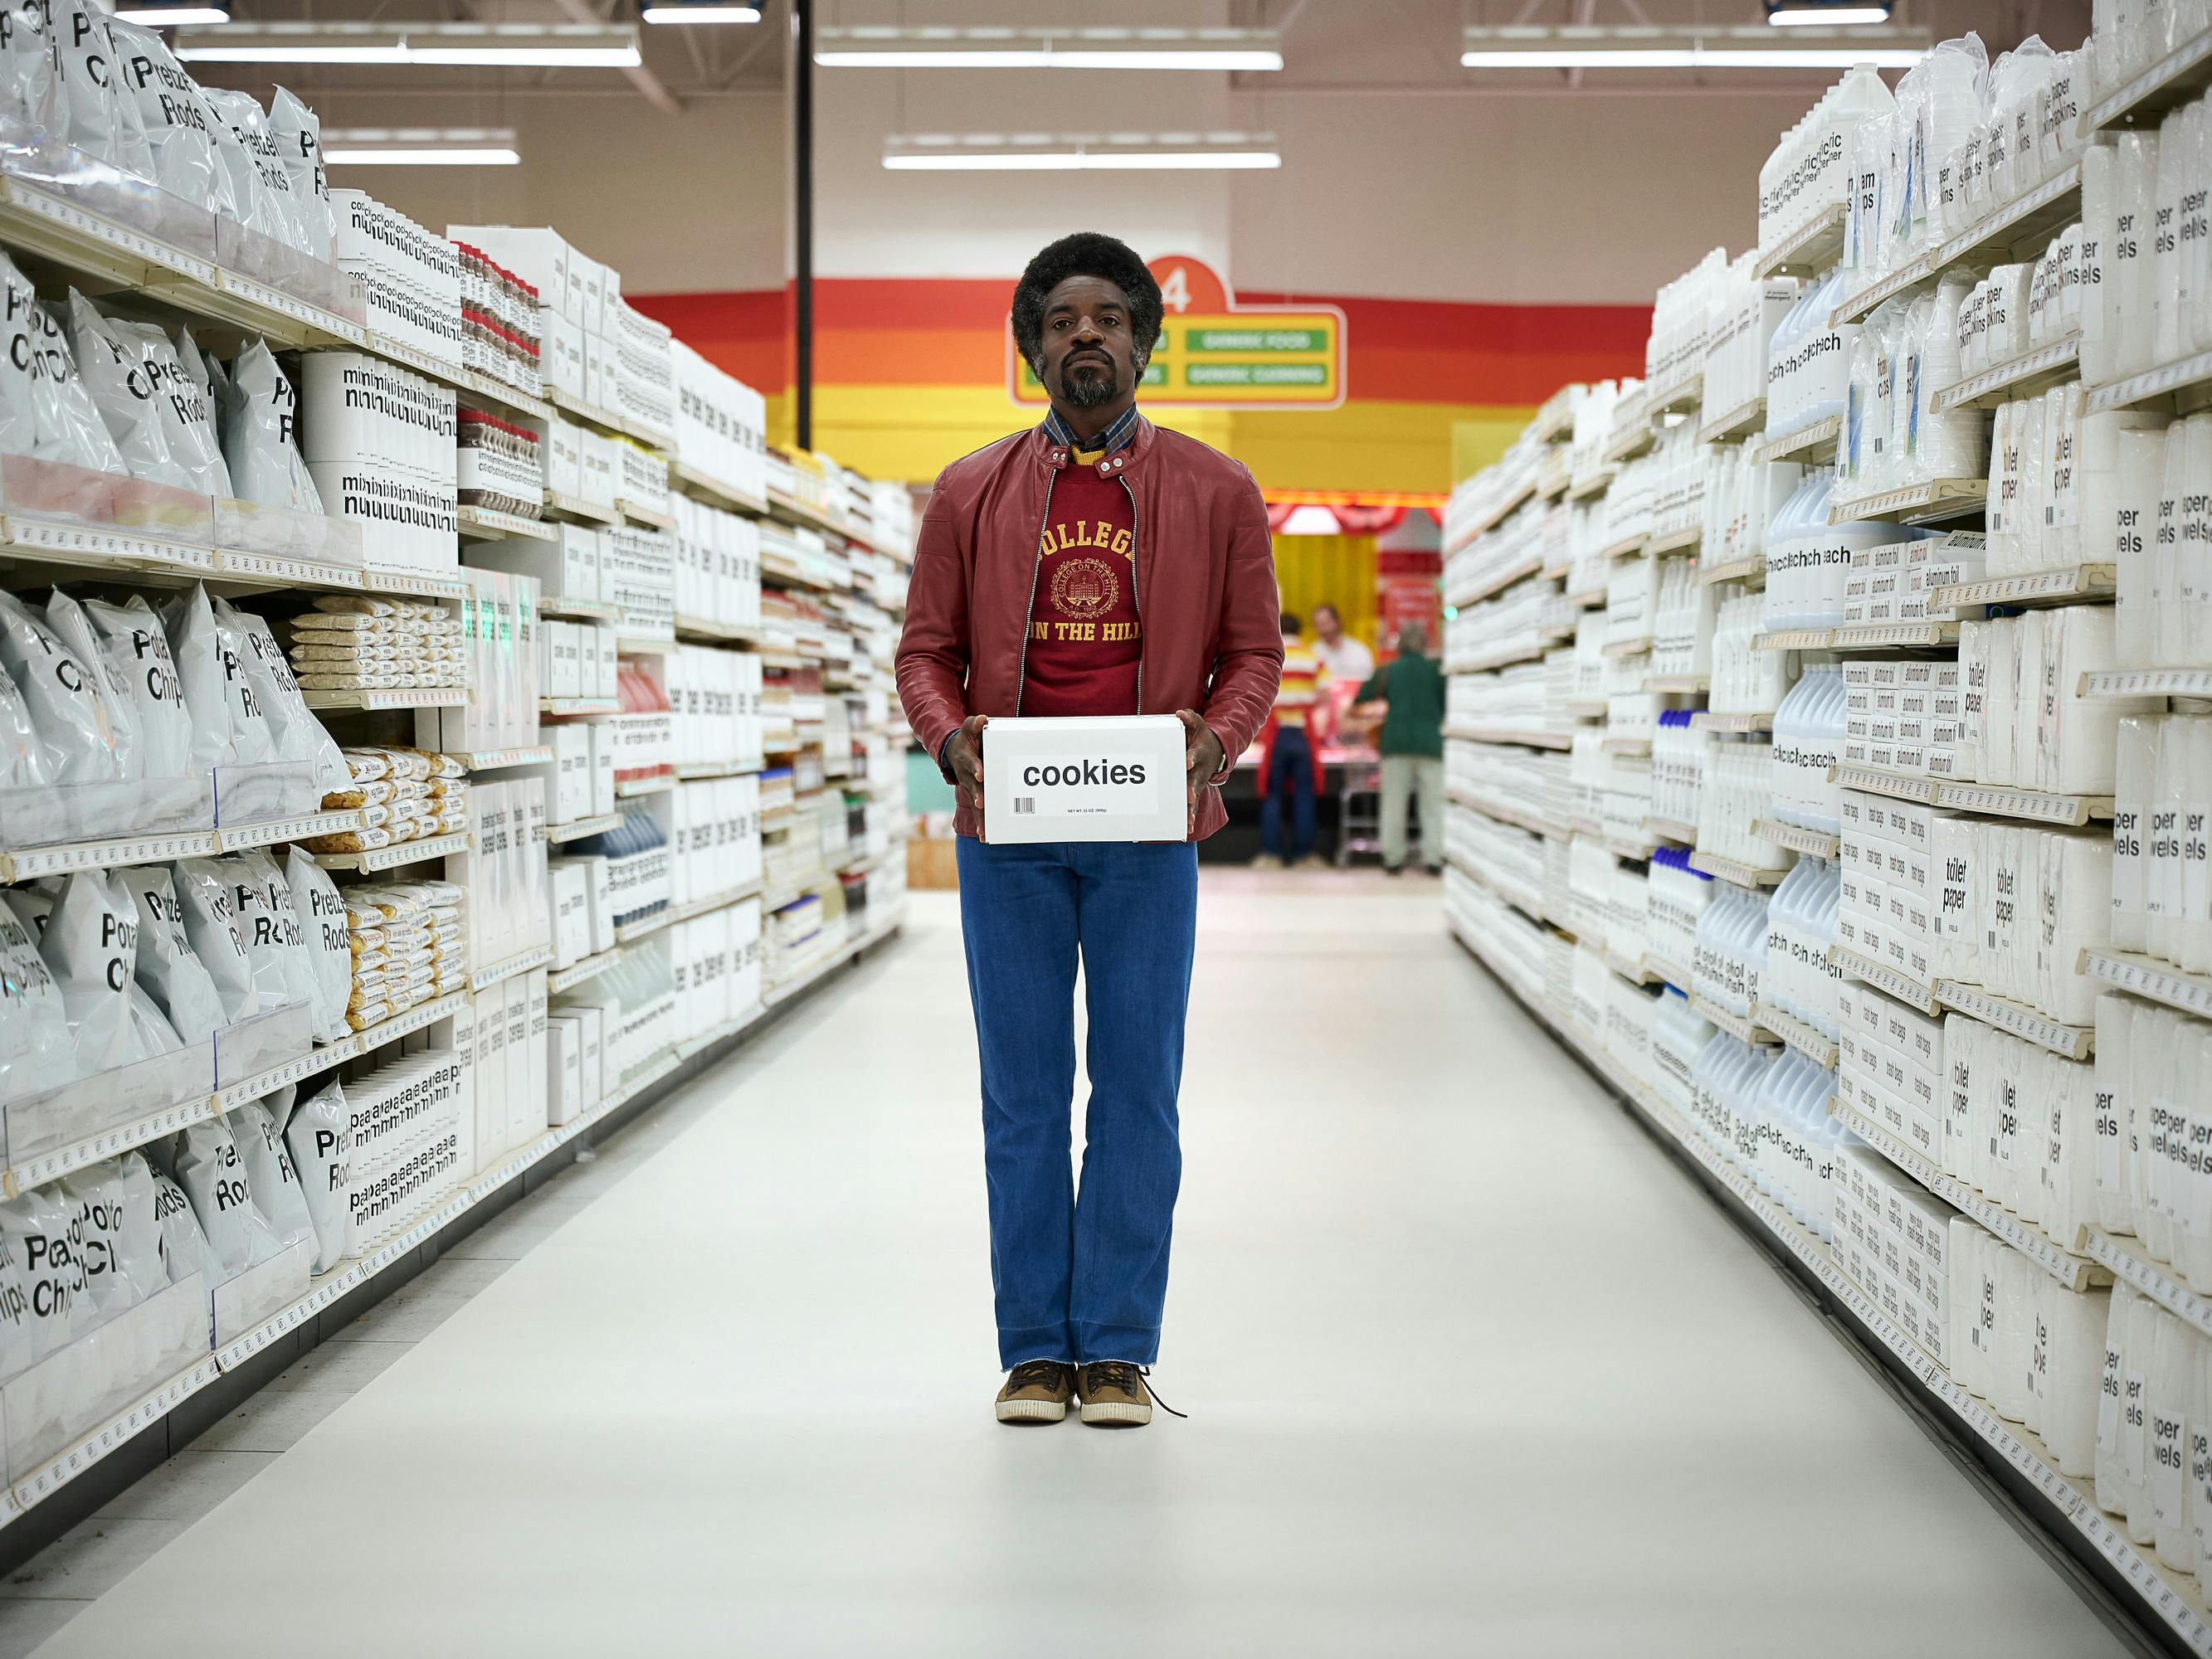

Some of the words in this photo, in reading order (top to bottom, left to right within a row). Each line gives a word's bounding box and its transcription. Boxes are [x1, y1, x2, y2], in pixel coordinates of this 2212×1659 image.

[1162, 267, 1191, 314] 4
[1038, 521, 1133, 561] OLLEG
[1947, 533, 1985, 551] aluminum
[1093, 566, 1108, 579] THE
[1926, 567, 1951, 586] aluminum
[1951, 565, 1960, 584] foil
[1055, 622, 1095, 641] THE
[1102, 622, 1143, 641] HILL
[1023, 759, 1146, 786] cookies
